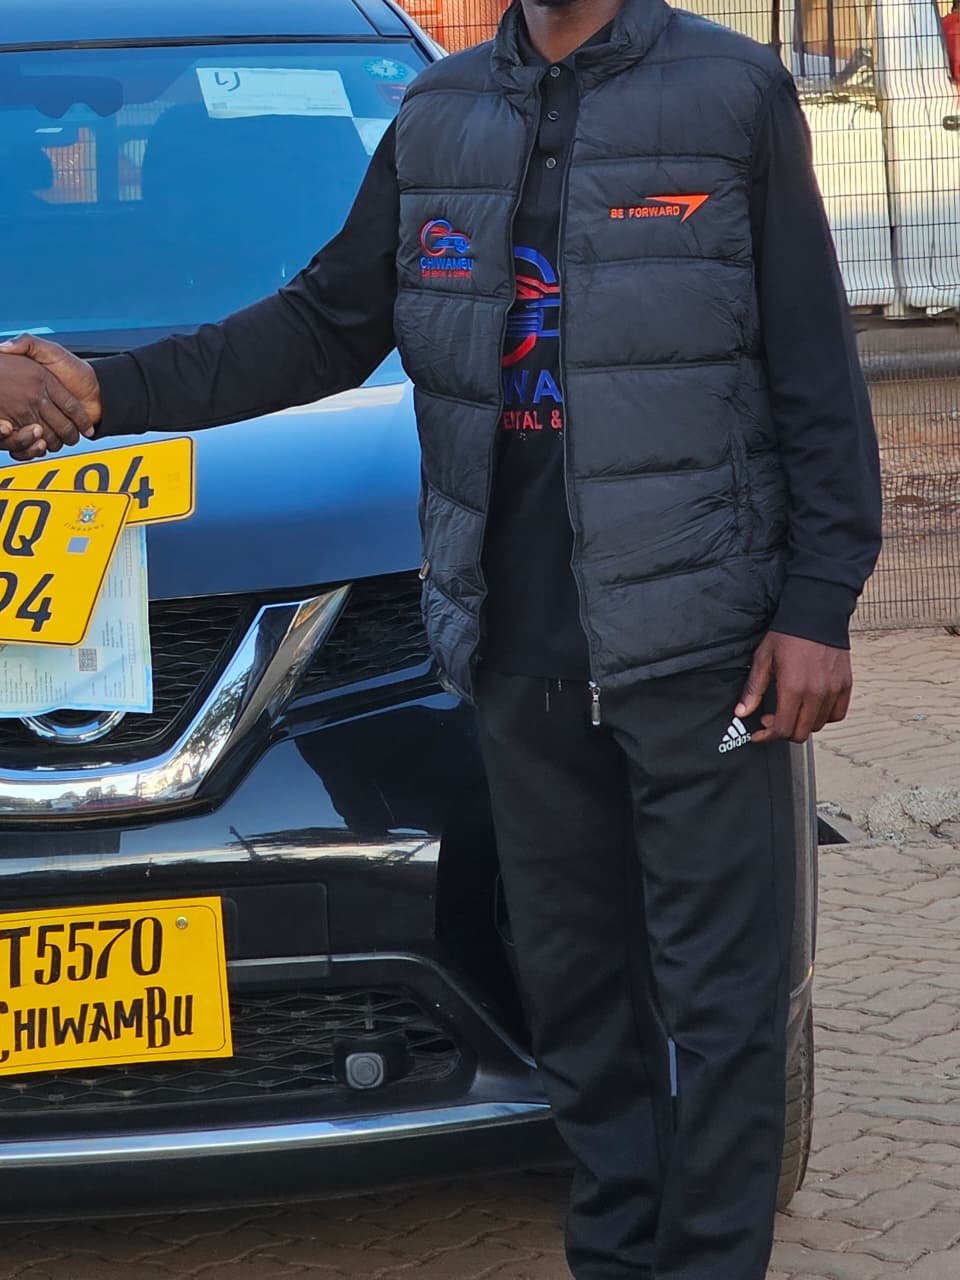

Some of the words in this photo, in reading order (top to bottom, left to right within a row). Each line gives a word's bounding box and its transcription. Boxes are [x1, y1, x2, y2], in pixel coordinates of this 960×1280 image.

[610, 208, 624, 219] BE
[629, 206, 680, 218] FORWARD
[718, 732, 751, 753] adidas
